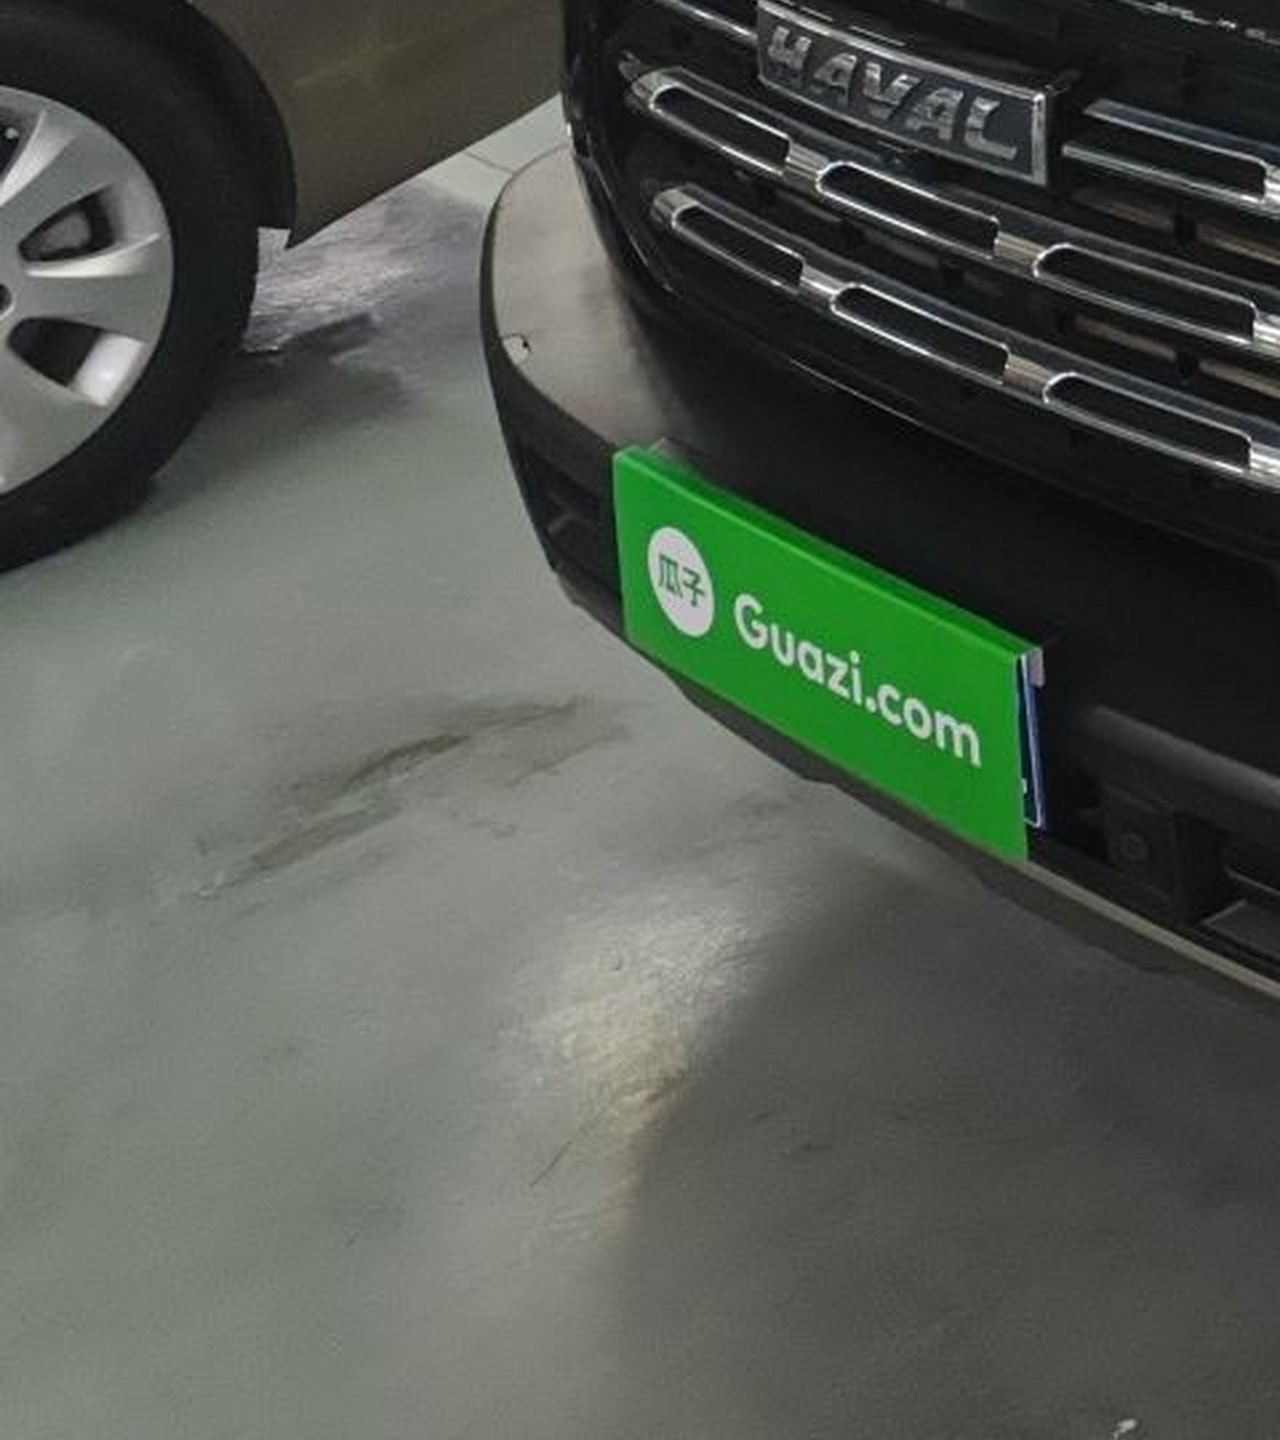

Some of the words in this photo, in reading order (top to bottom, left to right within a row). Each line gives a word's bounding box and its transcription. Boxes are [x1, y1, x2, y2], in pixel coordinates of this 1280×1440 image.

[768, 25, 1018, 160] HAVAL
[658, 553, 706, 608] 瓜子
[734, 593, 982, 767] Guazi.com
